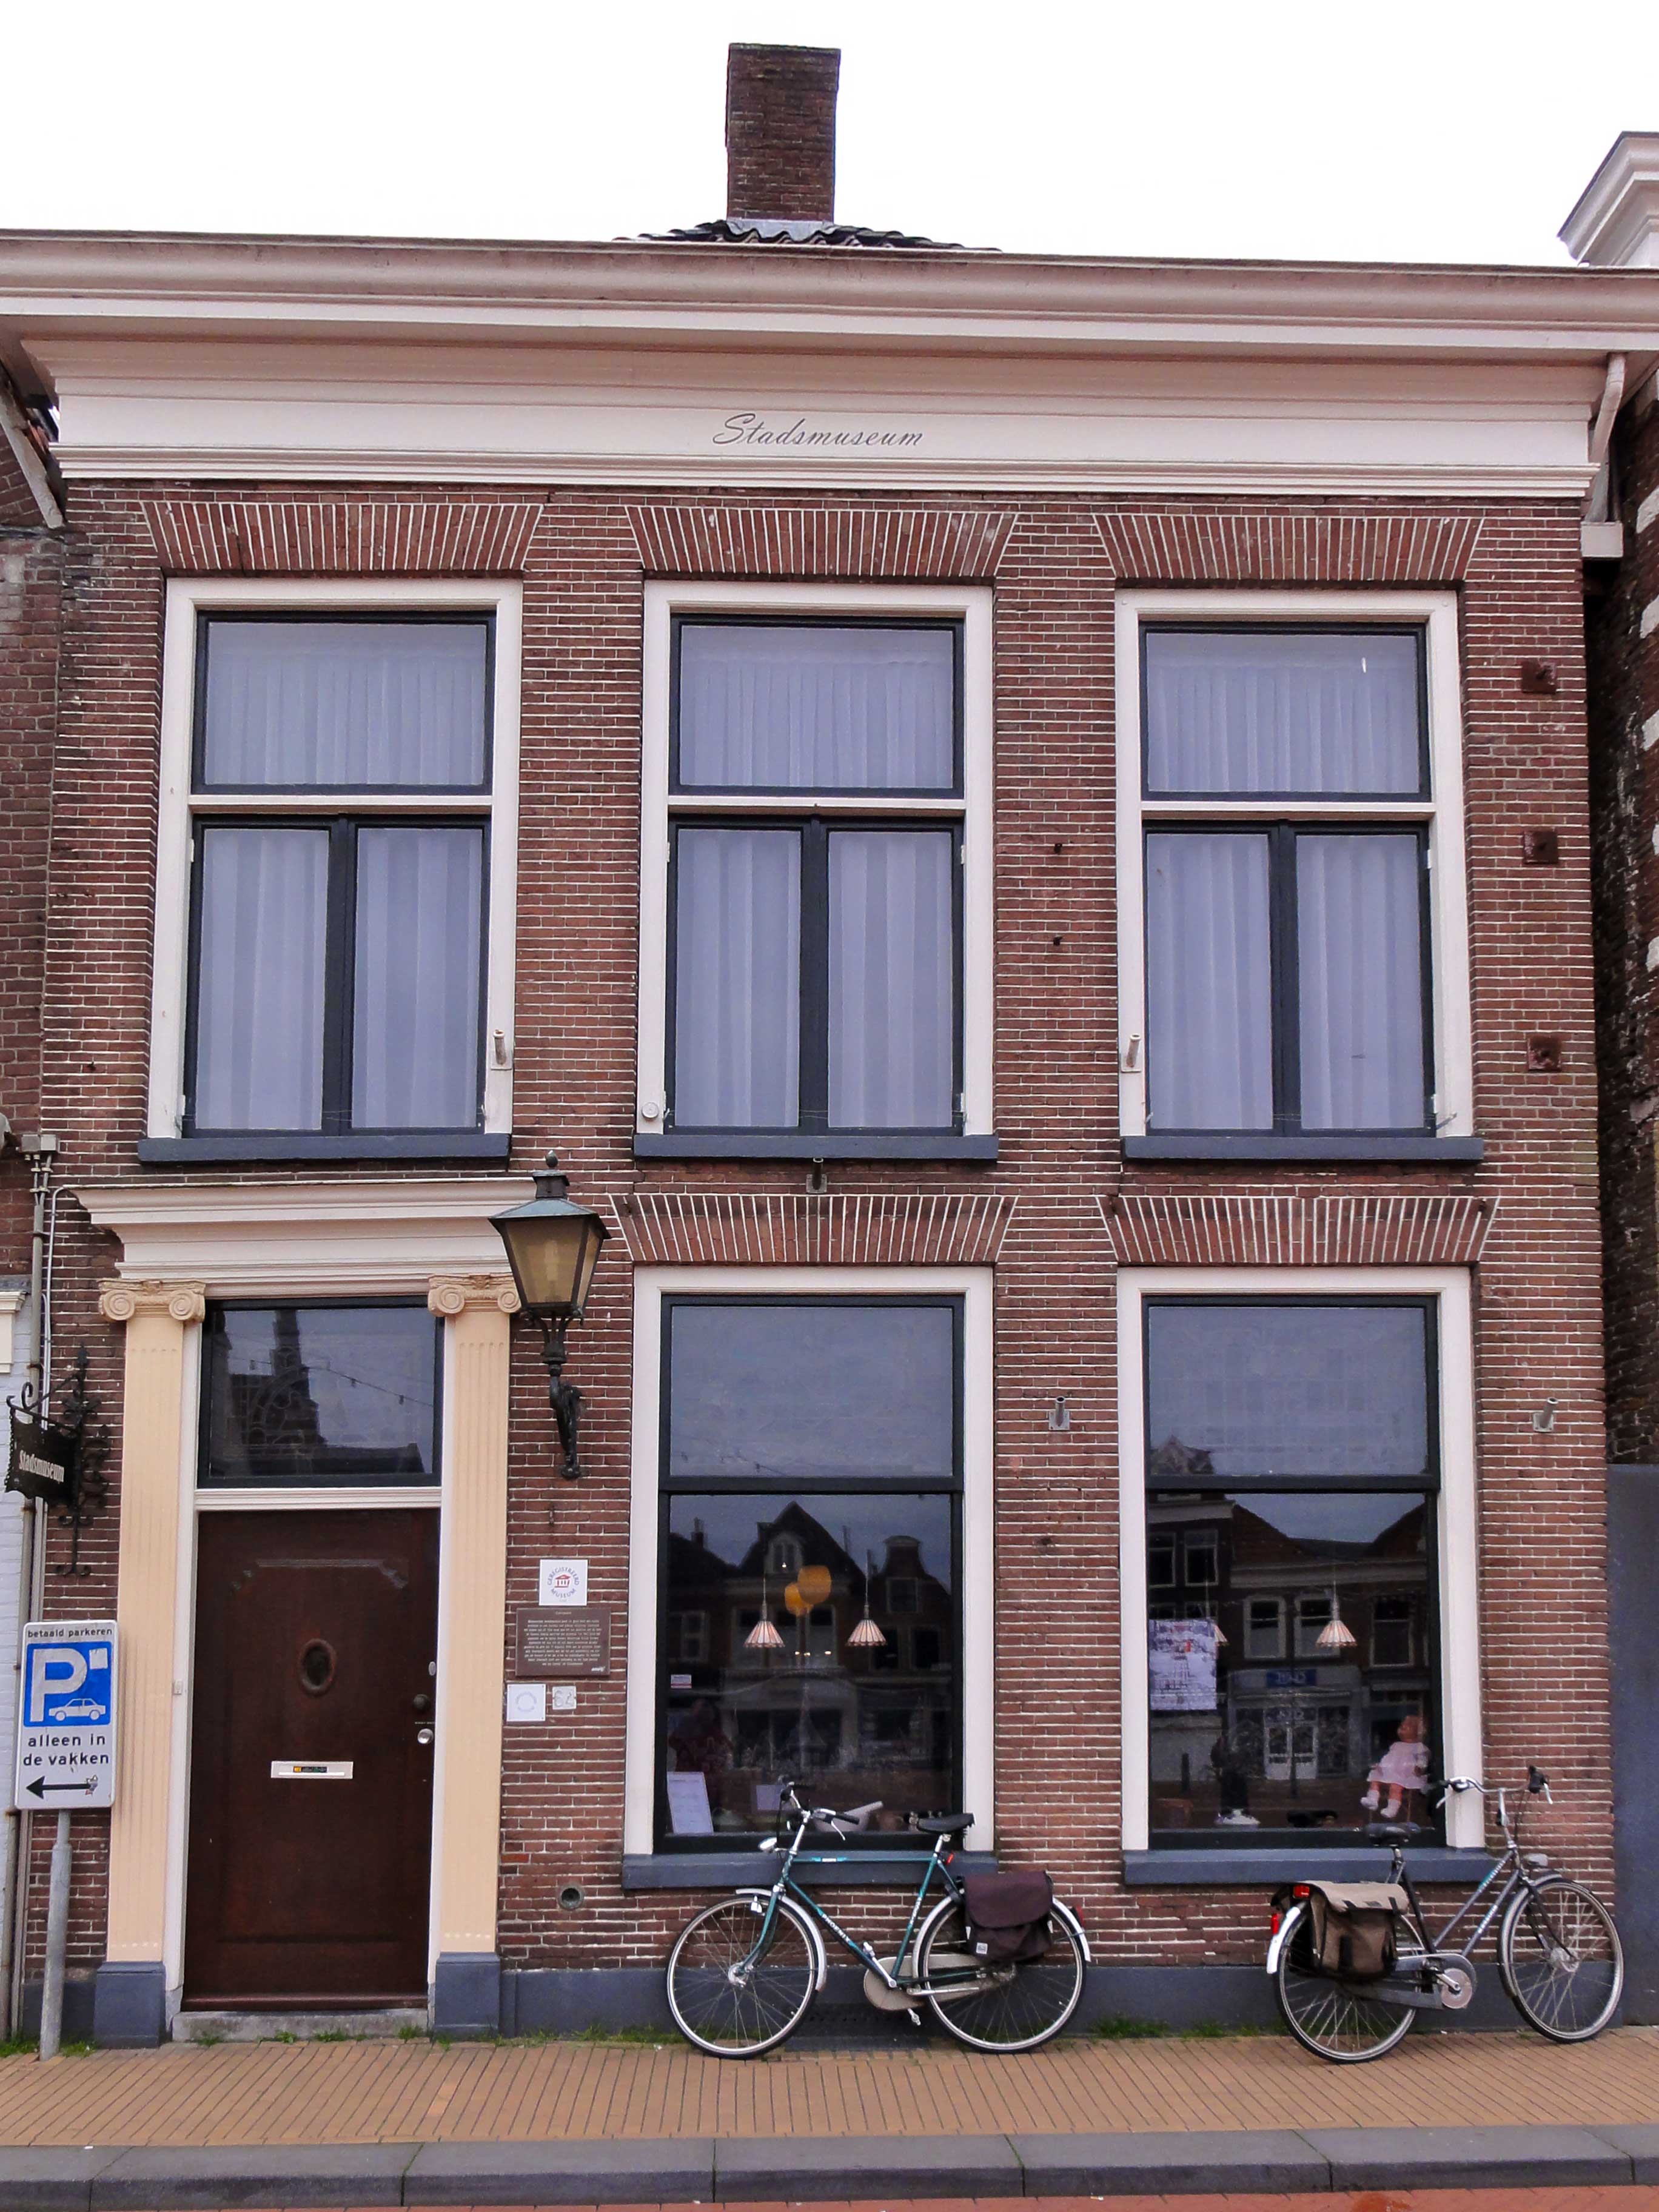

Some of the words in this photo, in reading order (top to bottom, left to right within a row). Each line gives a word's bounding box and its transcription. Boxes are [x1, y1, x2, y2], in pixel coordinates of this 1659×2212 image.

[712, 413, 923, 446] Stadsmuseum
[19, 1450, 64, 1483] Stadsmuseum
[551, 1588, 577, 1598] MUSEUM
[28, 1629, 64, 1638] betaald
[68, 1628, 112, 1637] parkeren
[30, 1648, 87, 1723] P
[28, 1735, 81, 1747] alleen
[90, 1734, 106, 1745] in
[23, 1754, 43, 1766] de
[49, 1752, 109, 1766] vakken
[822, 1913, 850, 1942] PHOENIX
